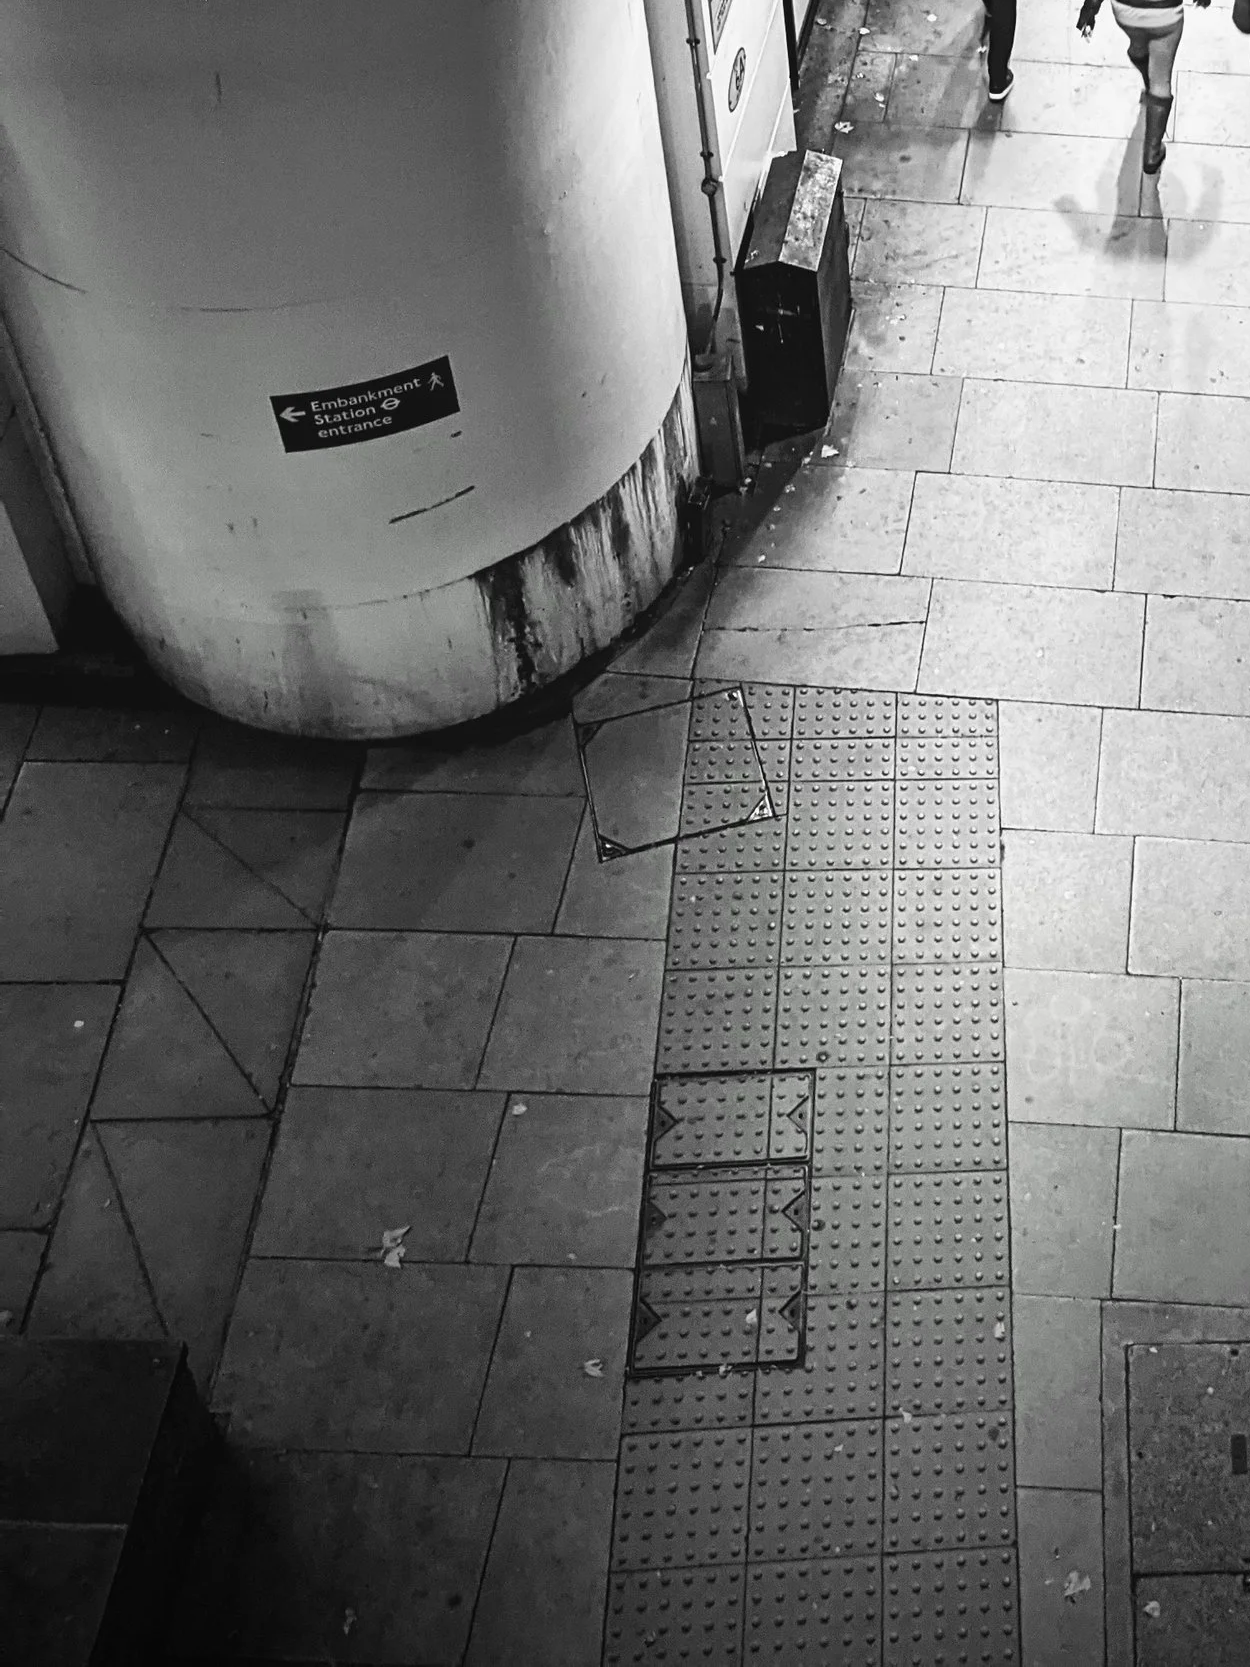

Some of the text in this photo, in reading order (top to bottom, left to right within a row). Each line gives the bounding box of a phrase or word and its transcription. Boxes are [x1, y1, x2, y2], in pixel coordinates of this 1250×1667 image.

[311, 378, 421, 412] Embankment
[314, 406, 376, 425] Station
[318, 416, 392, 438] entrance
